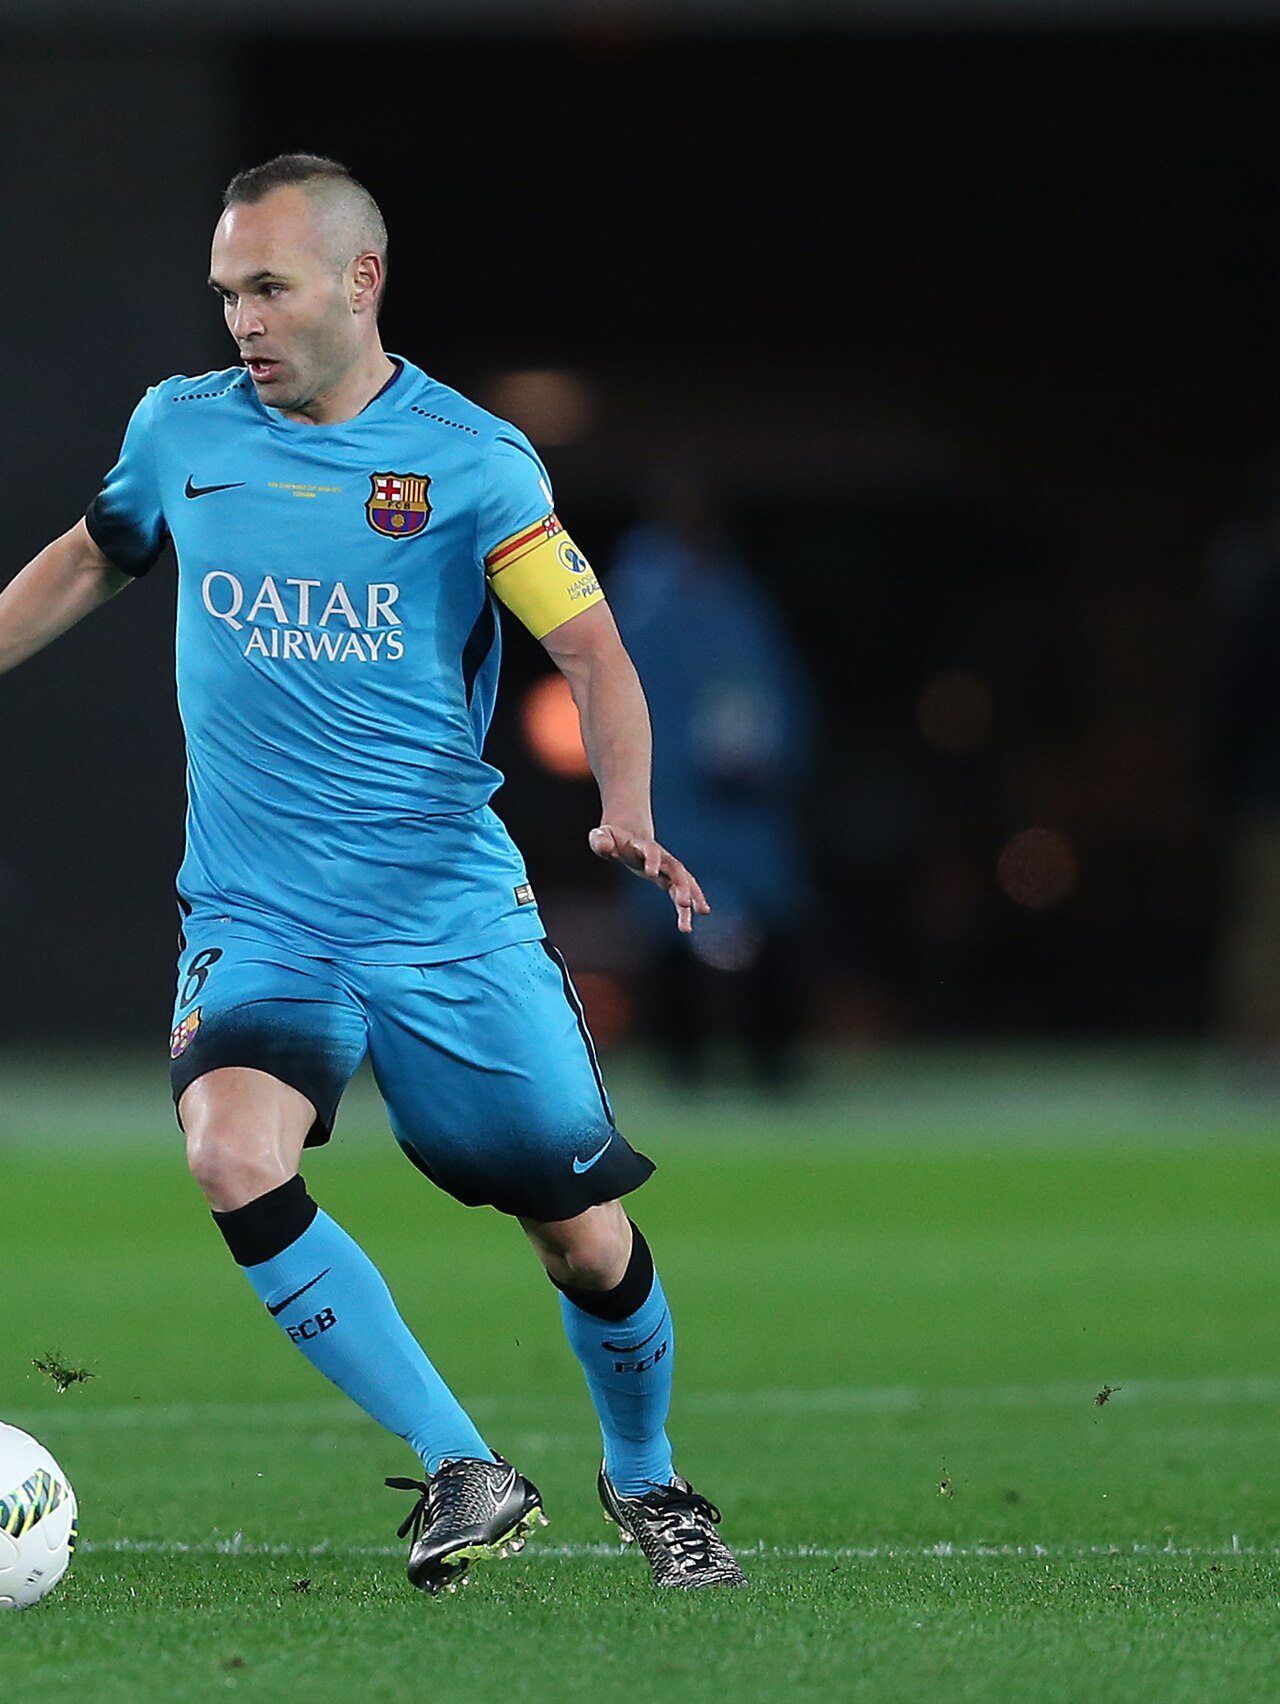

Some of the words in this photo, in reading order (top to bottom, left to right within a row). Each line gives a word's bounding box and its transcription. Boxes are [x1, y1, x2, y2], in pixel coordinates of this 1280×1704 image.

[201, 570, 402, 631] QATAR
[243, 627, 405, 662] AIRWAYS
[180, 947, 223, 1010] 8
[285, 1307, 337, 1344] FCB
[615, 1341, 667, 1373] FCB
